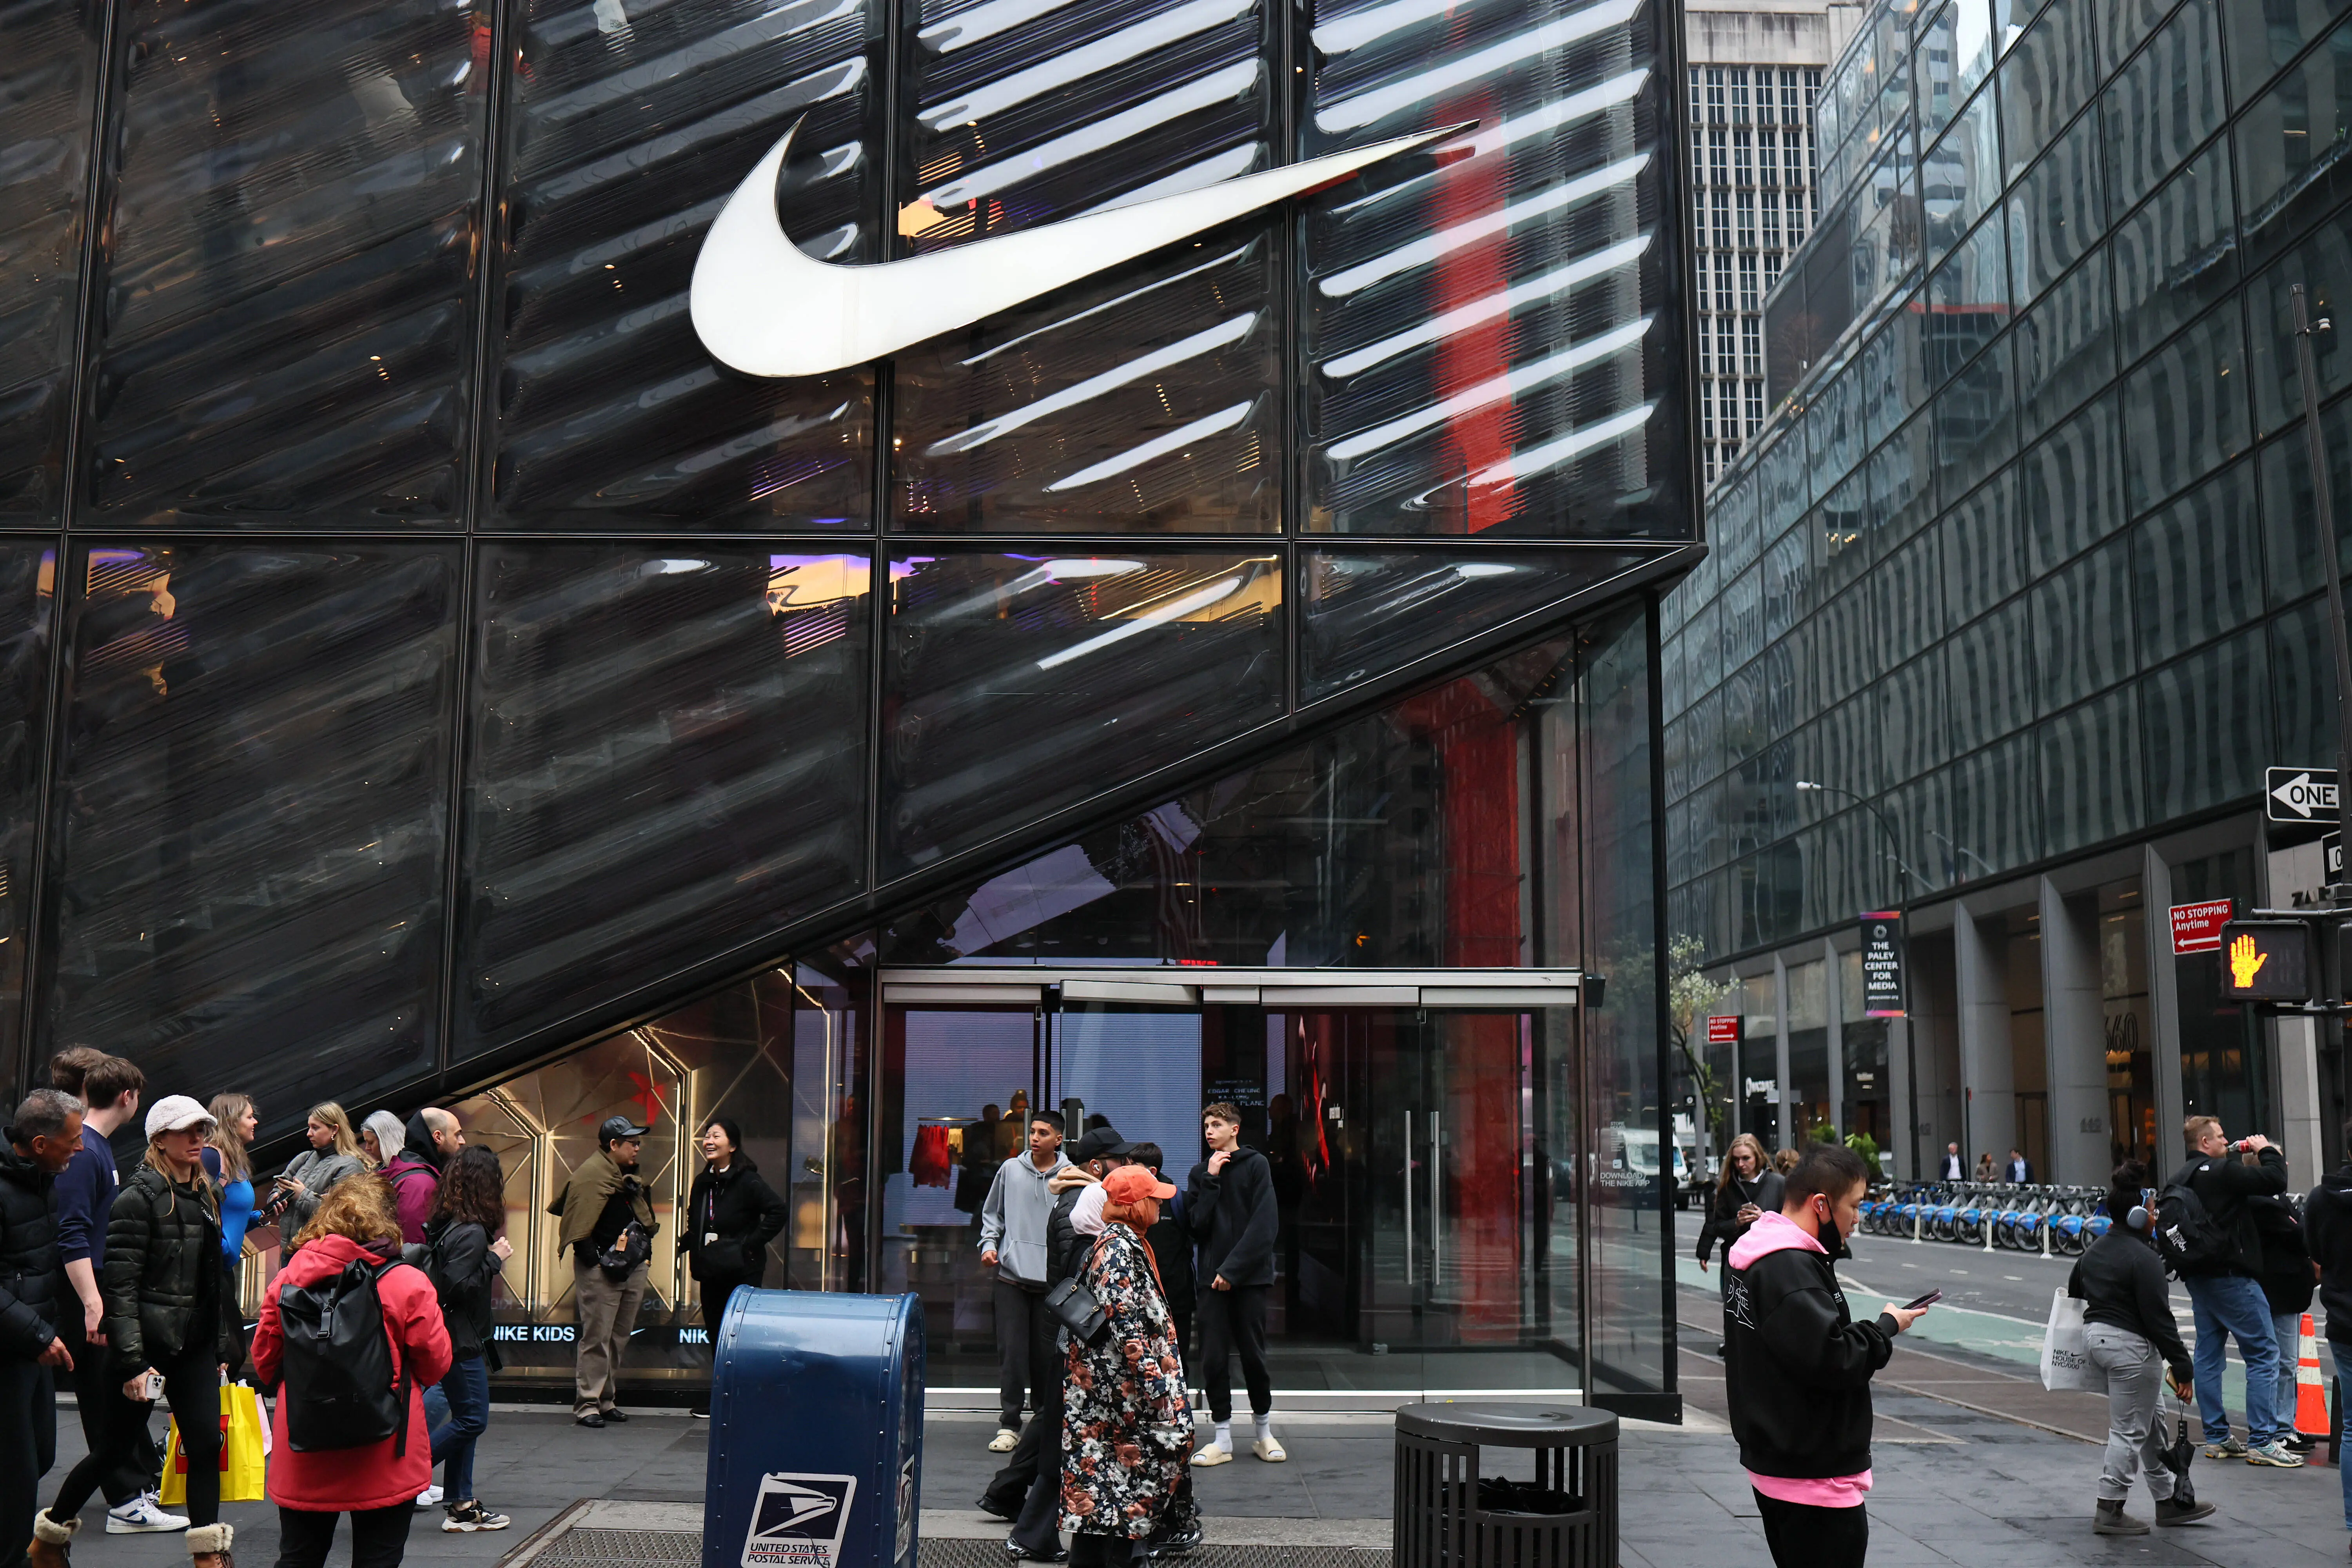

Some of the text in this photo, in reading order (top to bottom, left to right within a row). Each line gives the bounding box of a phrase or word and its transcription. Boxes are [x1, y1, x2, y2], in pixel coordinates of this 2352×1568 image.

[2290, 786, 2336, 806] ONE
[2174, 904, 2228, 921] NO STOPPING
[2176, 919, 2209, 932] Anytime
[1871, 941, 1889, 950] THE
[1867, 951, 1895, 960] PALEY
[1864, 961, 1899, 971] CENTER
[1873, 971, 1892, 980] FOR
[1868, 981, 1897, 991] MEDIA
[533, 1326, 575, 1341] KIDS
[679, 1328, 710, 1343] NIK
[2053, 1355, 2076, 1364] HOUSE
[750, 1543, 828, 1553] UNITED STATES
[748, 1554, 786, 1564] POSTAL
